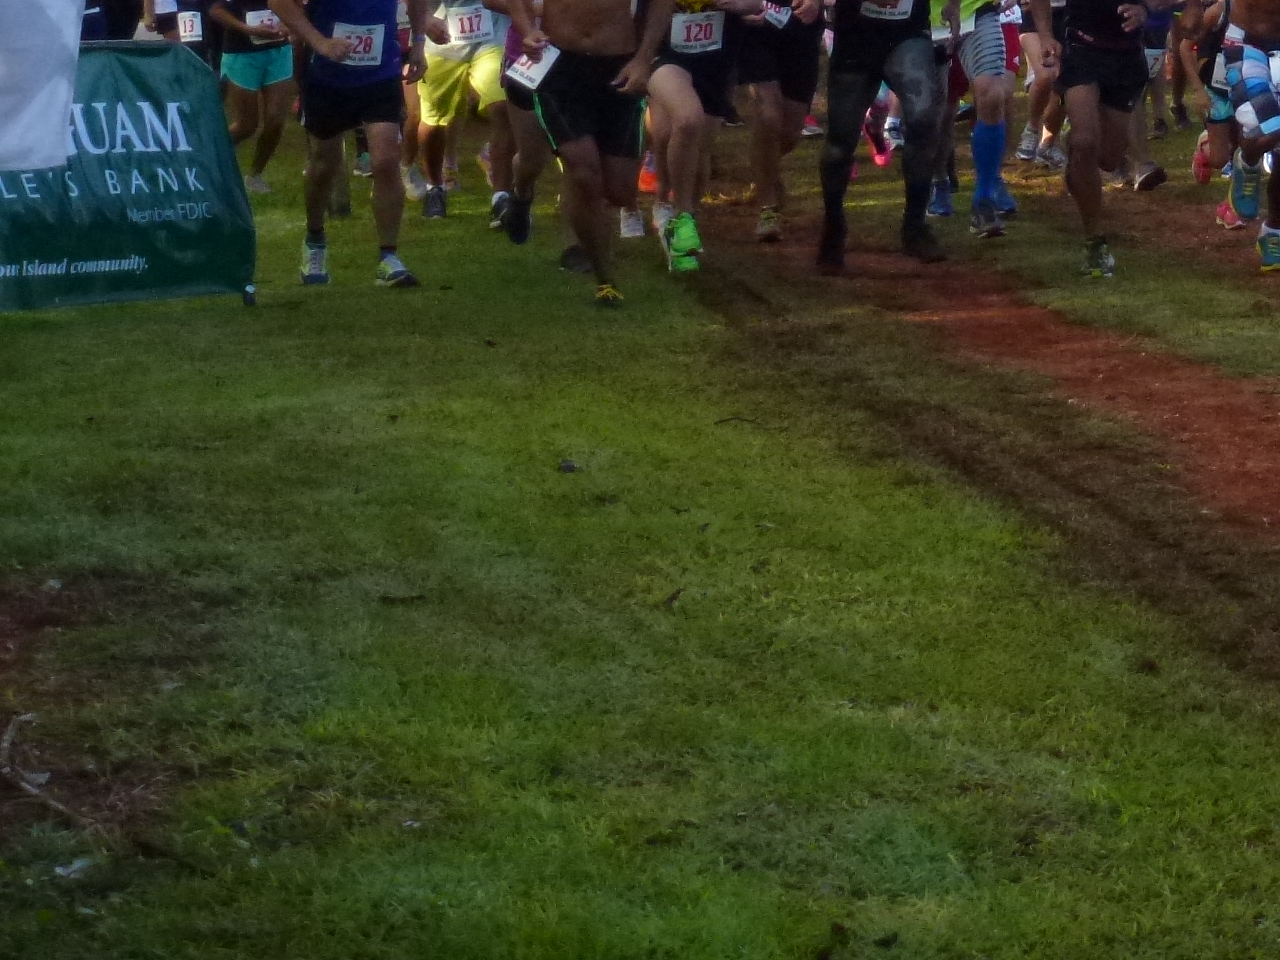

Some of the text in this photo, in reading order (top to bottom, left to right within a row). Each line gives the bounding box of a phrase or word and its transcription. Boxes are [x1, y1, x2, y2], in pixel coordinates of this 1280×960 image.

[458, 13, 483, 34] 117
[683, 23, 713, 42] 120
[104, 167, 205, 195] BANK
[177, 201, 213, 221] FDIC
[22, 257, 68, 276] Island
[70, 254, 149, 276] community.
